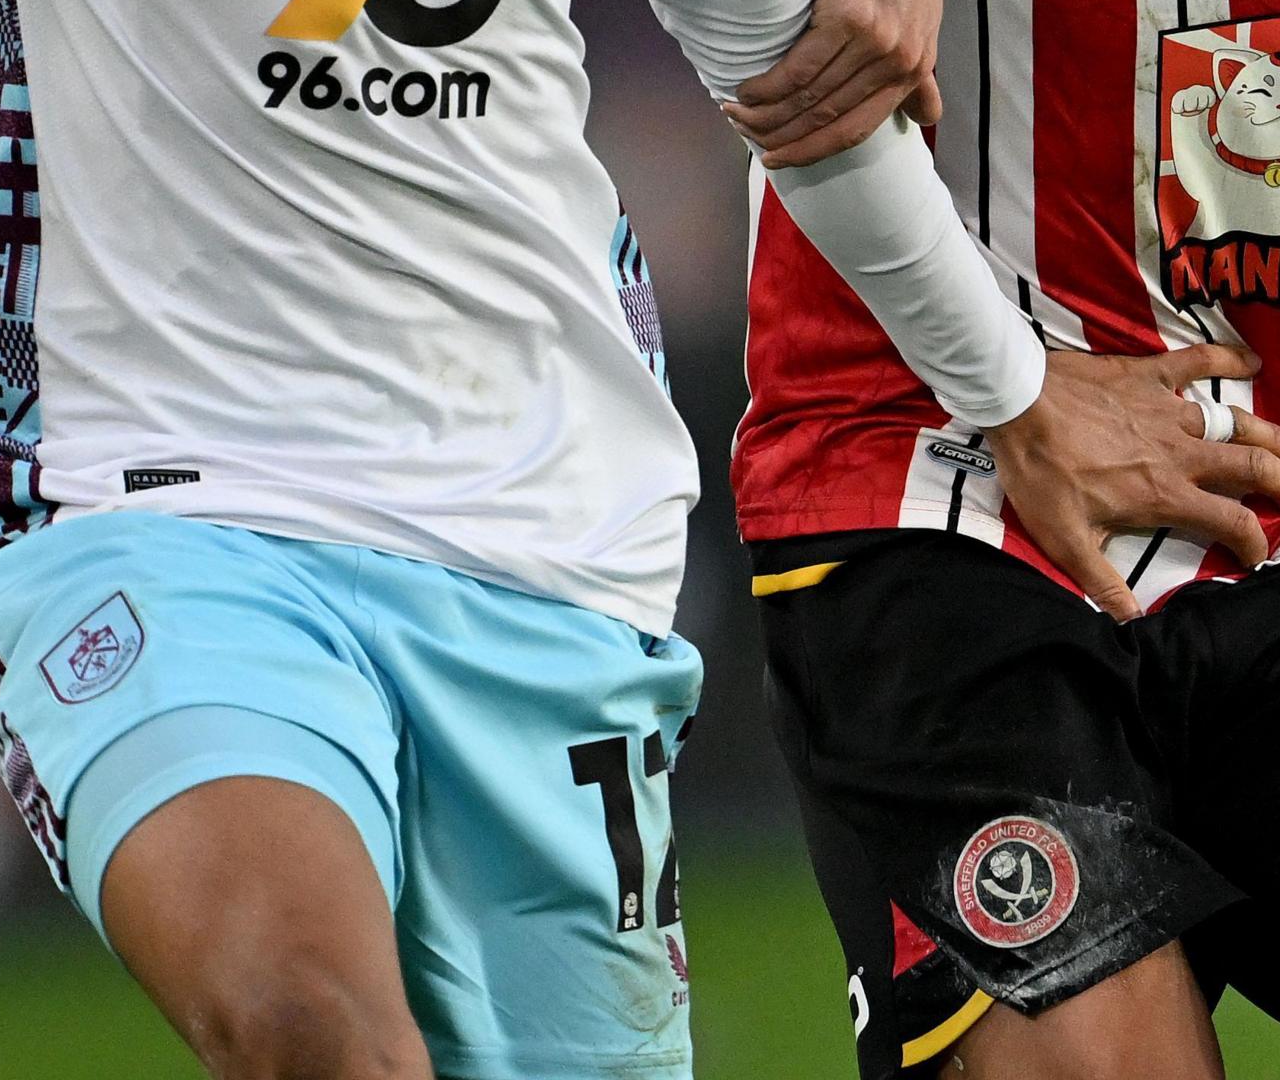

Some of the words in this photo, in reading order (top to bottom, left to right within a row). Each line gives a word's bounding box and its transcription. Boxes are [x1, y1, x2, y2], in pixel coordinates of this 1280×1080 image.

[257, 51, 491, 120] 96.com
[961, 839, 988, 911] SHEFFIELD
[989, 824, 1038, 842] UNITED
[1038, 835, 1059, 857] F.C.
[624, 917, 638, 929] EFL
